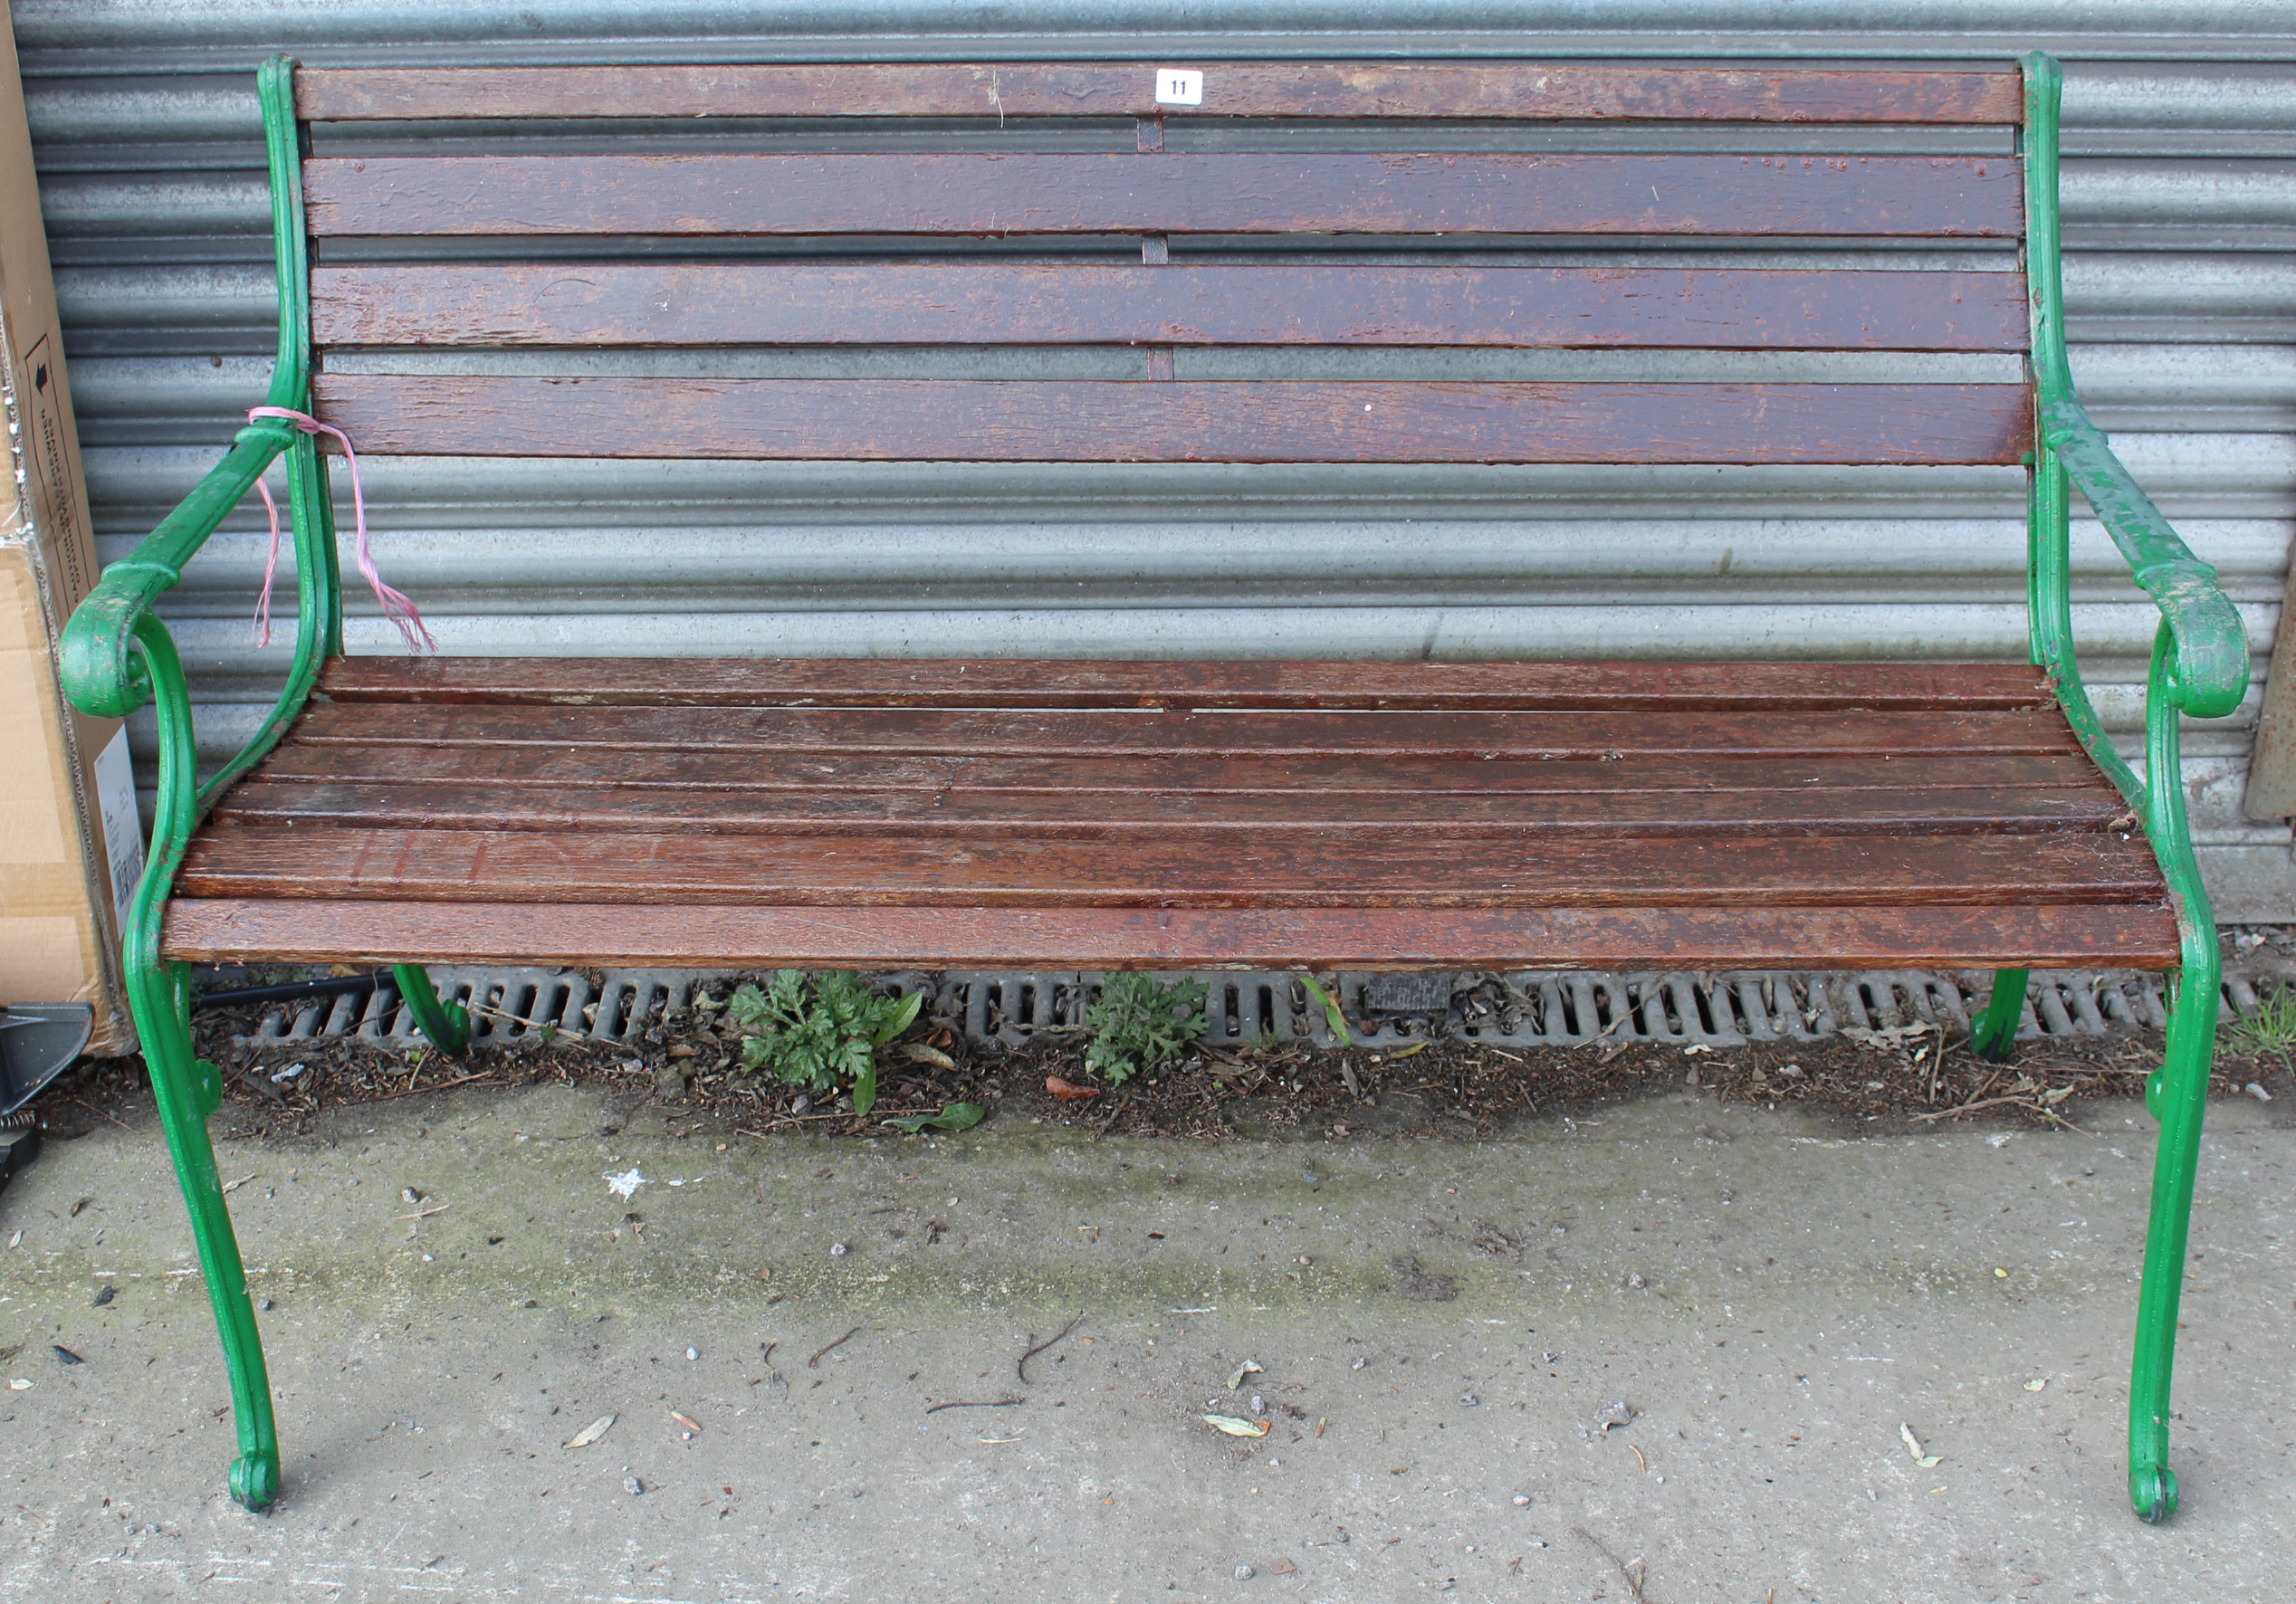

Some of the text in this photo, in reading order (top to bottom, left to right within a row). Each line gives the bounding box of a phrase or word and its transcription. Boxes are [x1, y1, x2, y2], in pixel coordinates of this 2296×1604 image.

[1172, 80, 1186, 95] 11
[41, 408, 52, 455] WHEN
[49, 455, 60, 499] CARE
[48, 417, 80, 584] OPENING WITH KNIVES
